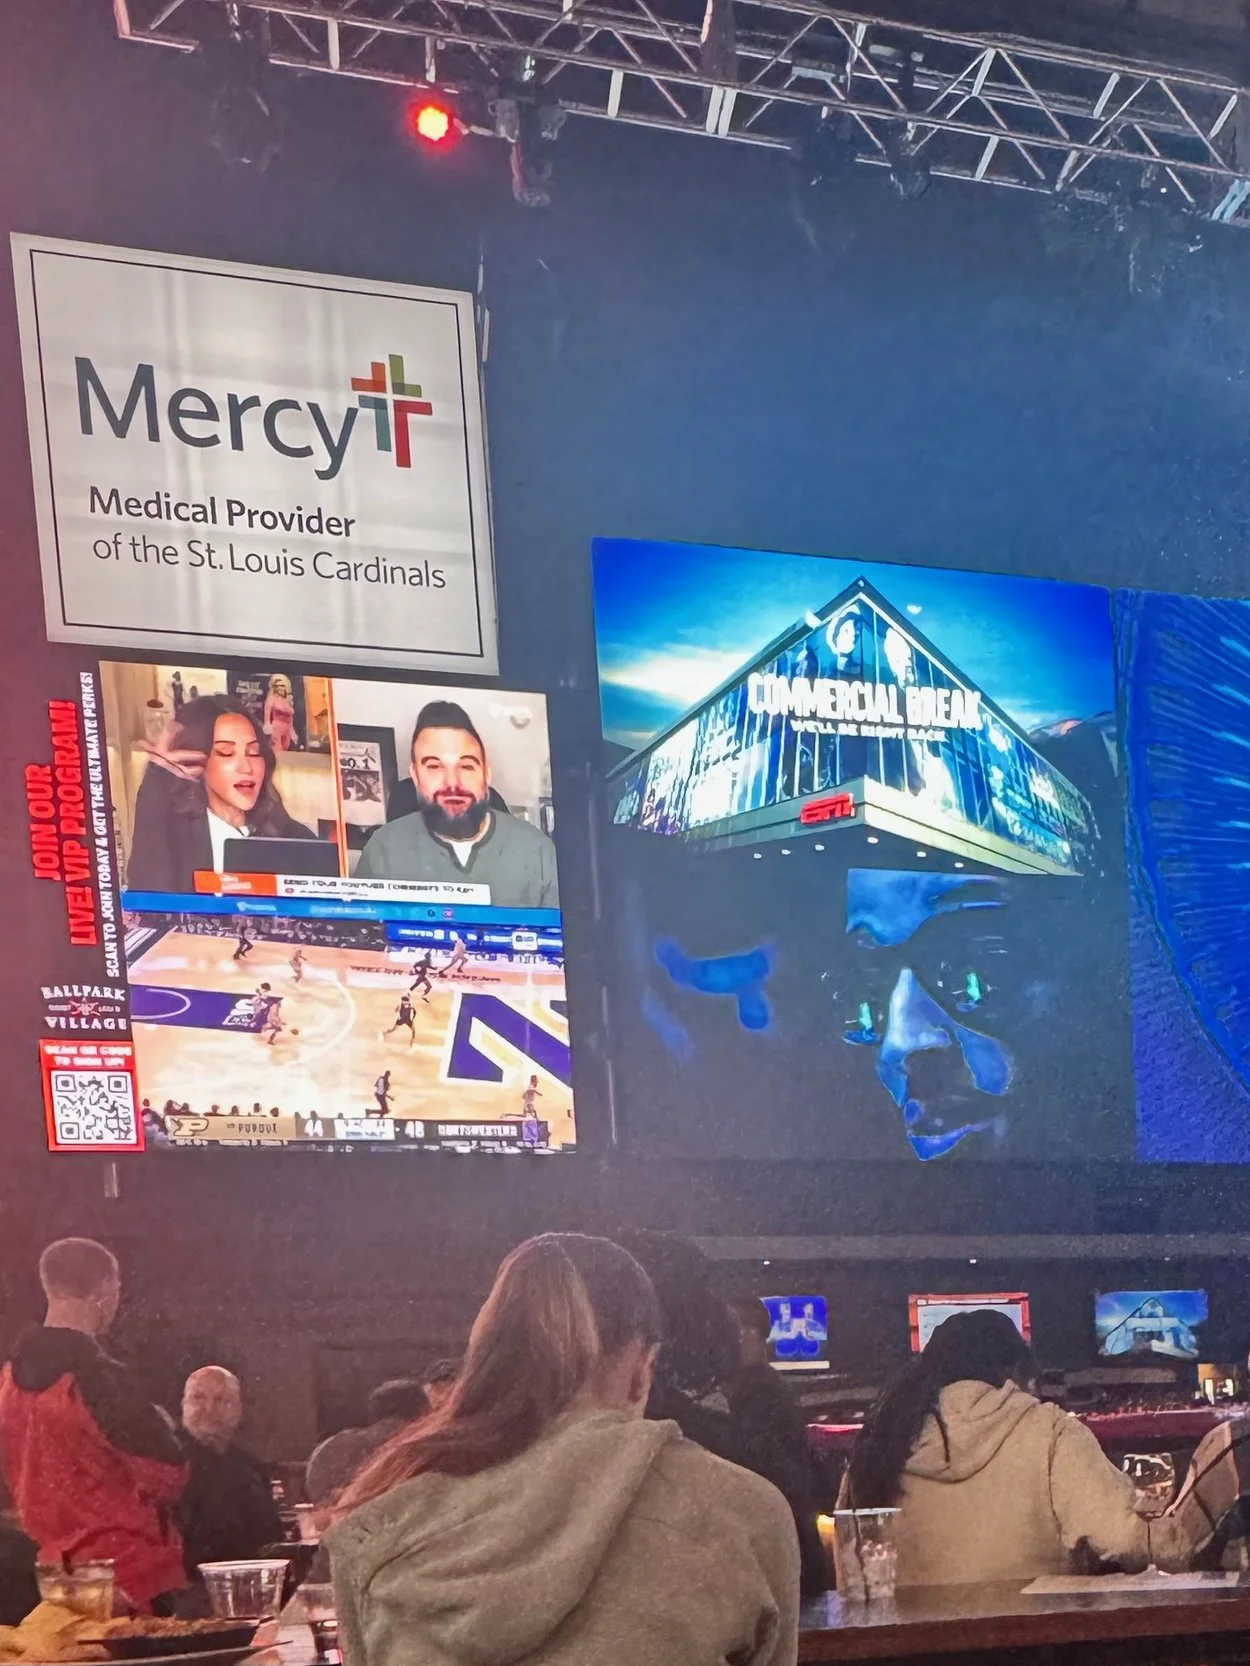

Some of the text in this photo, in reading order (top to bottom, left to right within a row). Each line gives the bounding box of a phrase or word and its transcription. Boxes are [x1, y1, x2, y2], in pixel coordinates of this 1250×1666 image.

[75, 356, 359, 480] Mercy
[89, 486, 356, 537] Medical Provider
[93, 533, 447, 589] of the St. Louis Cardinals
[748, 672, 904, 725] COMMERCIAL
[90, 783, 105, 809] THE
[25, 764, 61, 881] JOIN OUR
[48, 700, 98, 946] LIVE! VIP PROGRAM!
[95, 847, 112, 890] TODAY
[102, 923, 118, 942] TO
[104, 942, 120, 978] SCAN
[40, 984, 126, 1001] BALLPARK
[44, 1016, 127, 1030] VILLAGE
